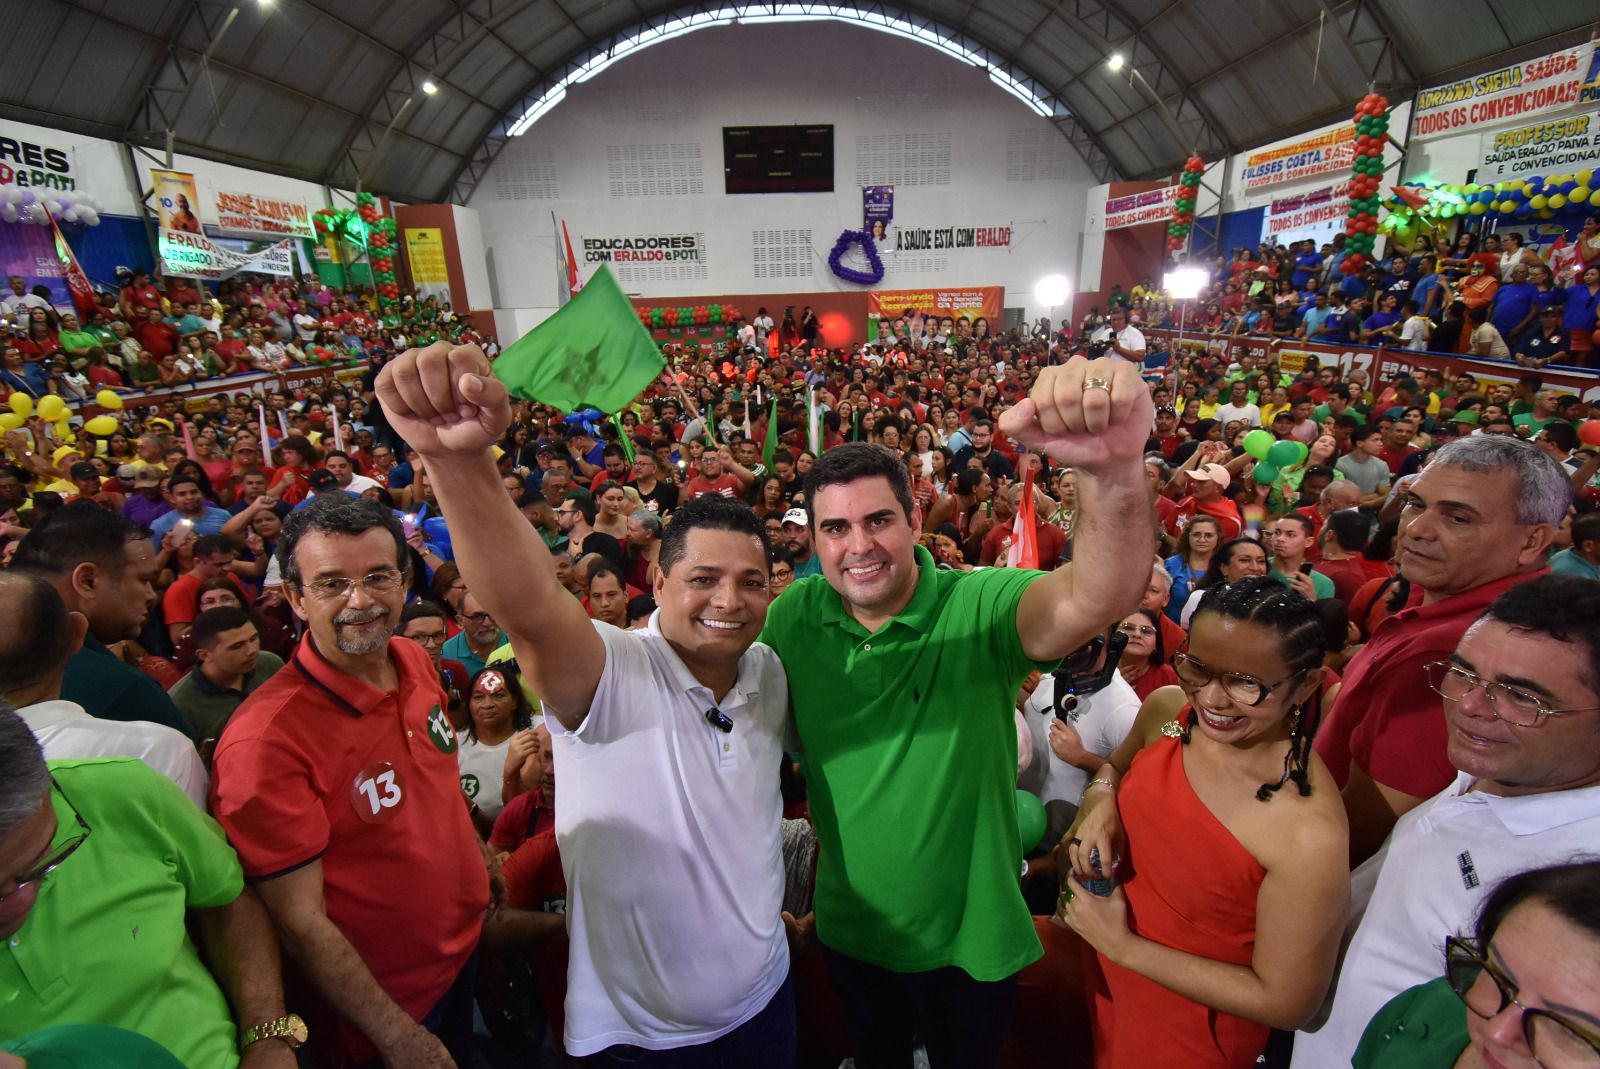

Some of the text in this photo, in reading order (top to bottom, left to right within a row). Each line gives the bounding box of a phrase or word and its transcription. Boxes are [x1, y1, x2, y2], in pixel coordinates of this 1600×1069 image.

[1418, 81, 1474, 111] ADRIANA
[1475, 66, 1522, 97] SHEILA
[1415, 80, 1580, 136] TODOS OS CONVENCIONAIS
[1493, 115, 1590, 152] PROFESSOR
[1518, 143, 1555, 160] ERALDO
[1558, 137, 1589, 151] PAIVA
[1247, 160, 1284, 179] ULISSES
[1497, 164, 1504, 174] E
[159, 197, 173, 208] 10
[1269, 215, 1292, 233] TODOS
[1293, 213, 1303, 228] OS
[584, 236, 696, 250] EDUCADORES
[897, 225, 1010, 251] A SAÚDE ESTÁ COM ERALDO
[164, 248, 212, 266] OBRIGADO
[585, 250, 612, 262] COM
[613, 250, 664, 262] ERALDO
[673, 249, 699, 260] POTI
[879, 293, 934, 303] Bem-vindo
[479, 671, 502, 695] 13
[359, 769, 402, 815] 13
